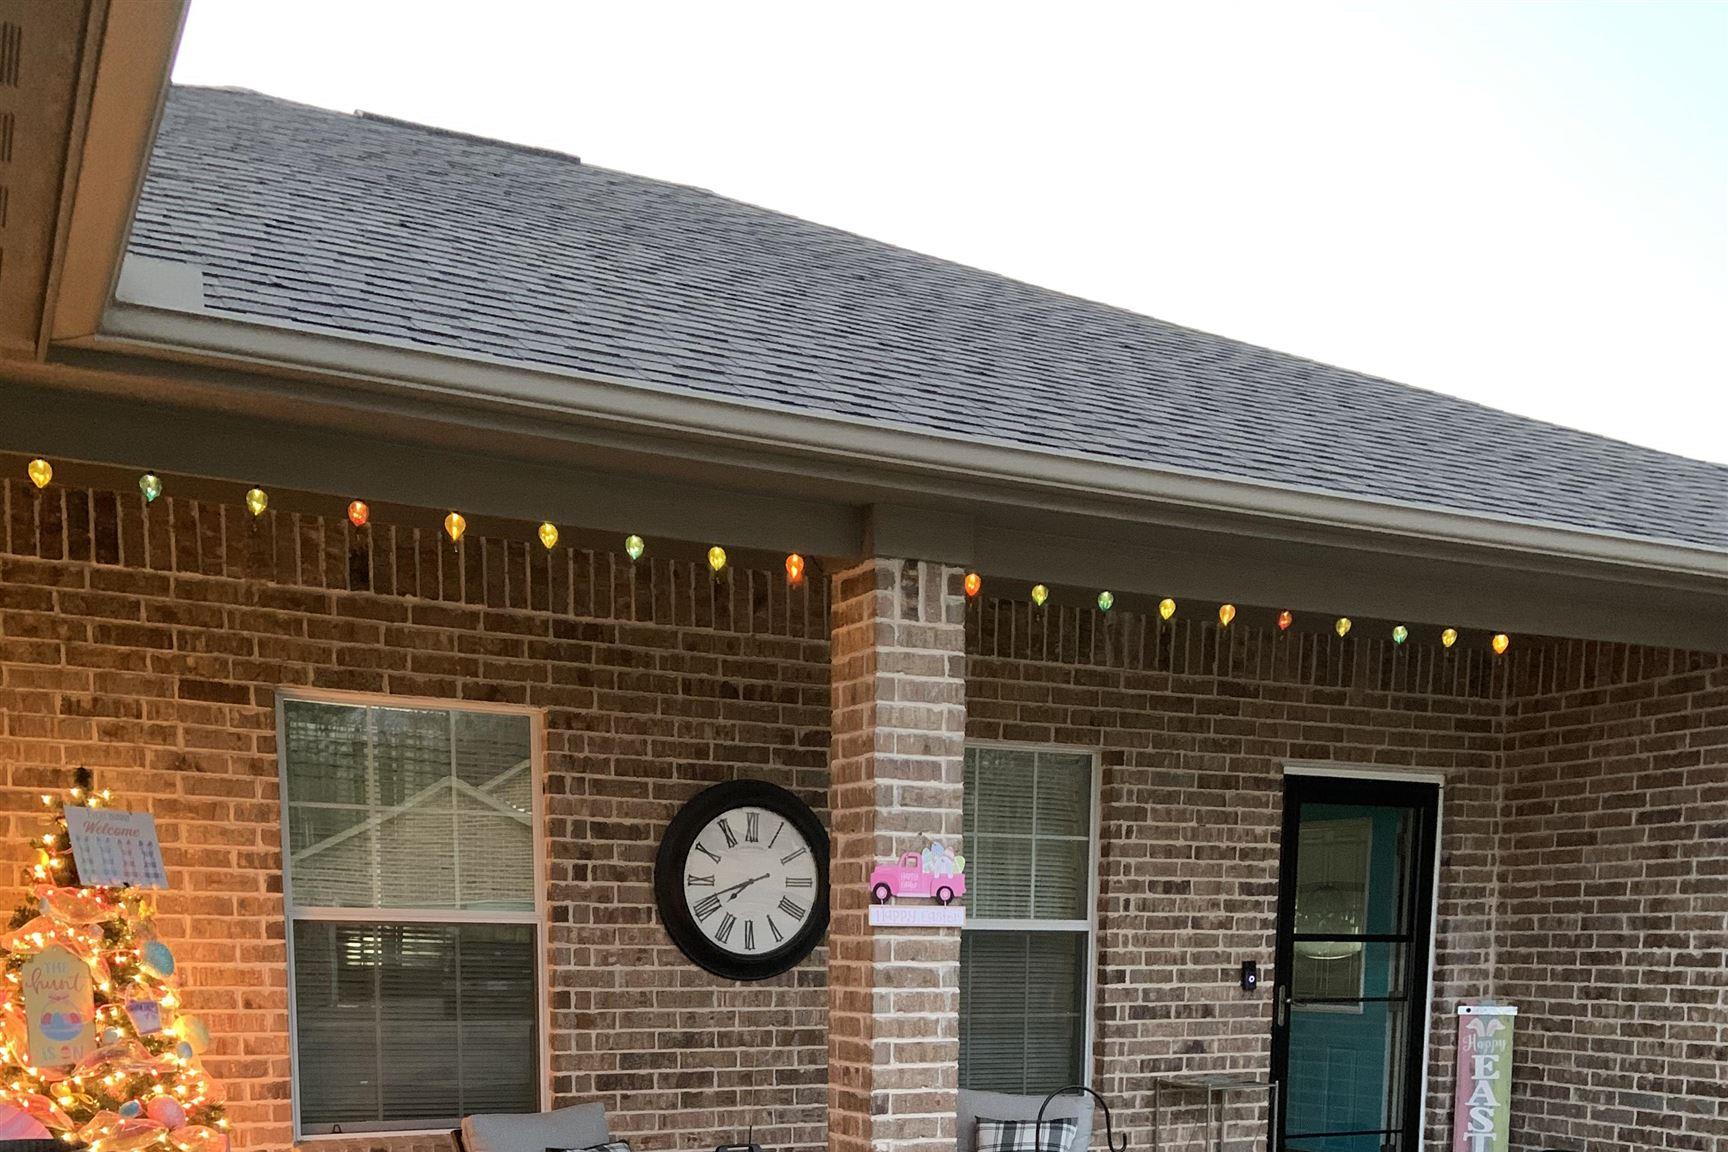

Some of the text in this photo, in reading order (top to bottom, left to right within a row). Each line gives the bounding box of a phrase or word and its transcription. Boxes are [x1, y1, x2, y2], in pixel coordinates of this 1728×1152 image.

[83, 820, 140, 838] Welcome
[717, 818, 738, 848] XI
[745, 811, 760, 843] XII
[695, 842, 722, 864] X
[687, 874, 716, 887] IX
[786, 876, 813, 888] III
[876, 909, 916, 923] Happy
[744, 920, 756, 950] VI
[766, 914, 784, 943] V
[44, 962, 67, 974] THE
[26, 967, 85, 994] hunt
[42, 1045, 84, 1060] IS ON
[1463, 1033, 1506, 1056] Happy
